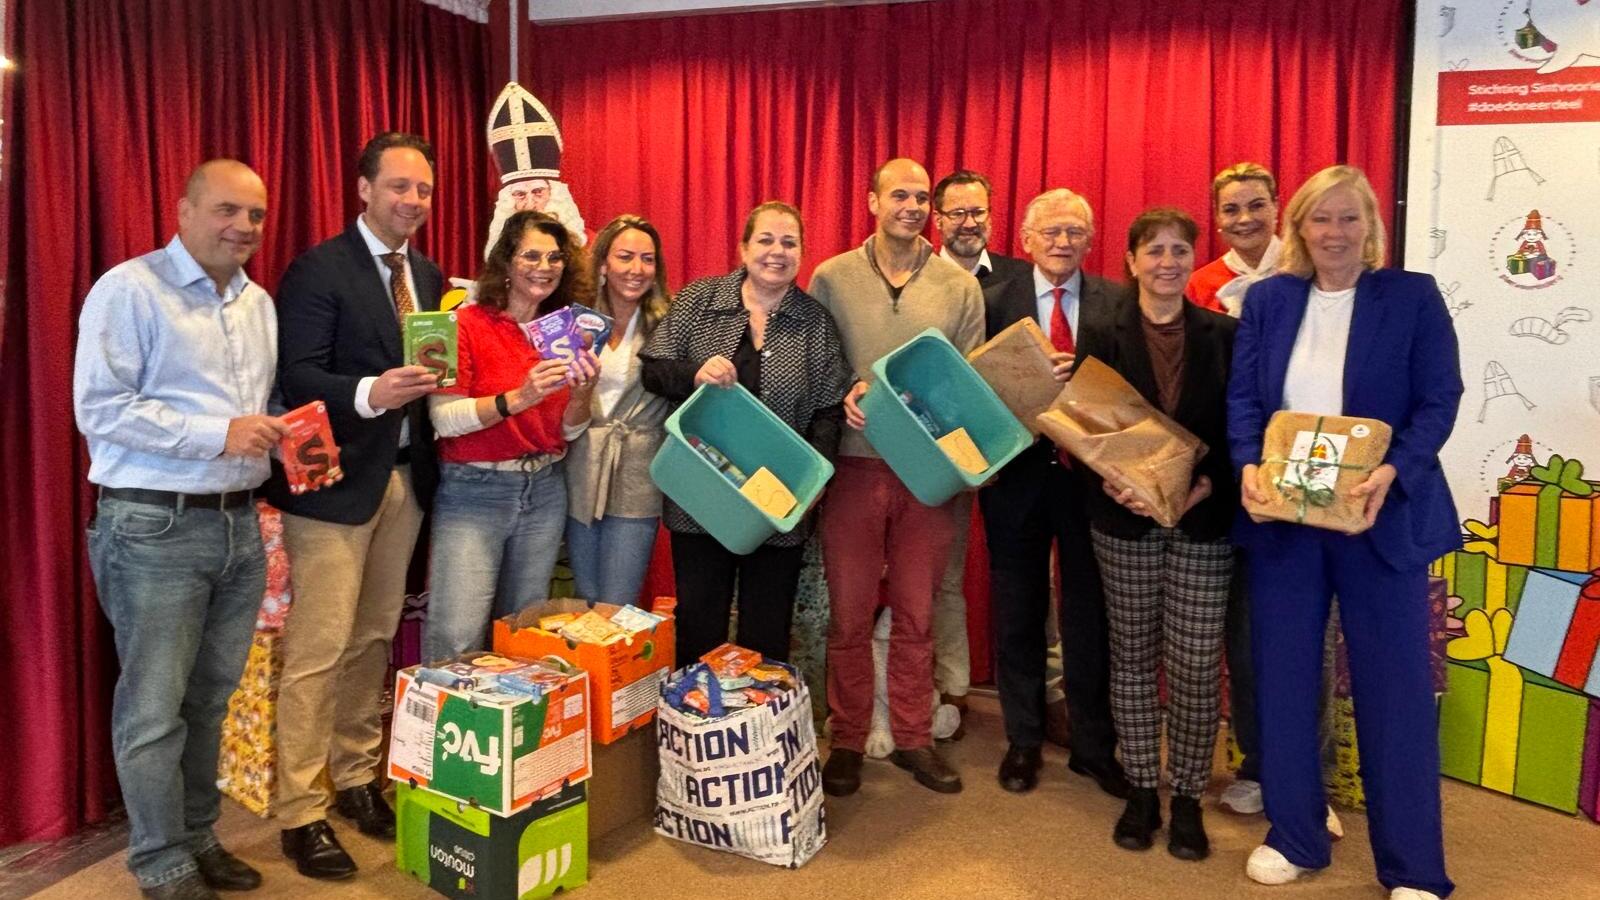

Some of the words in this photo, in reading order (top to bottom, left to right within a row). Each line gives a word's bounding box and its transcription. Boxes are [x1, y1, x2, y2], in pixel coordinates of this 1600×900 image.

[1467, 83, 1529, 96] Stichting
[440, 721, 502, 777] fvc
[659, 717, 750, 763] ACTION
[430, 844, 475, 878] mouton
